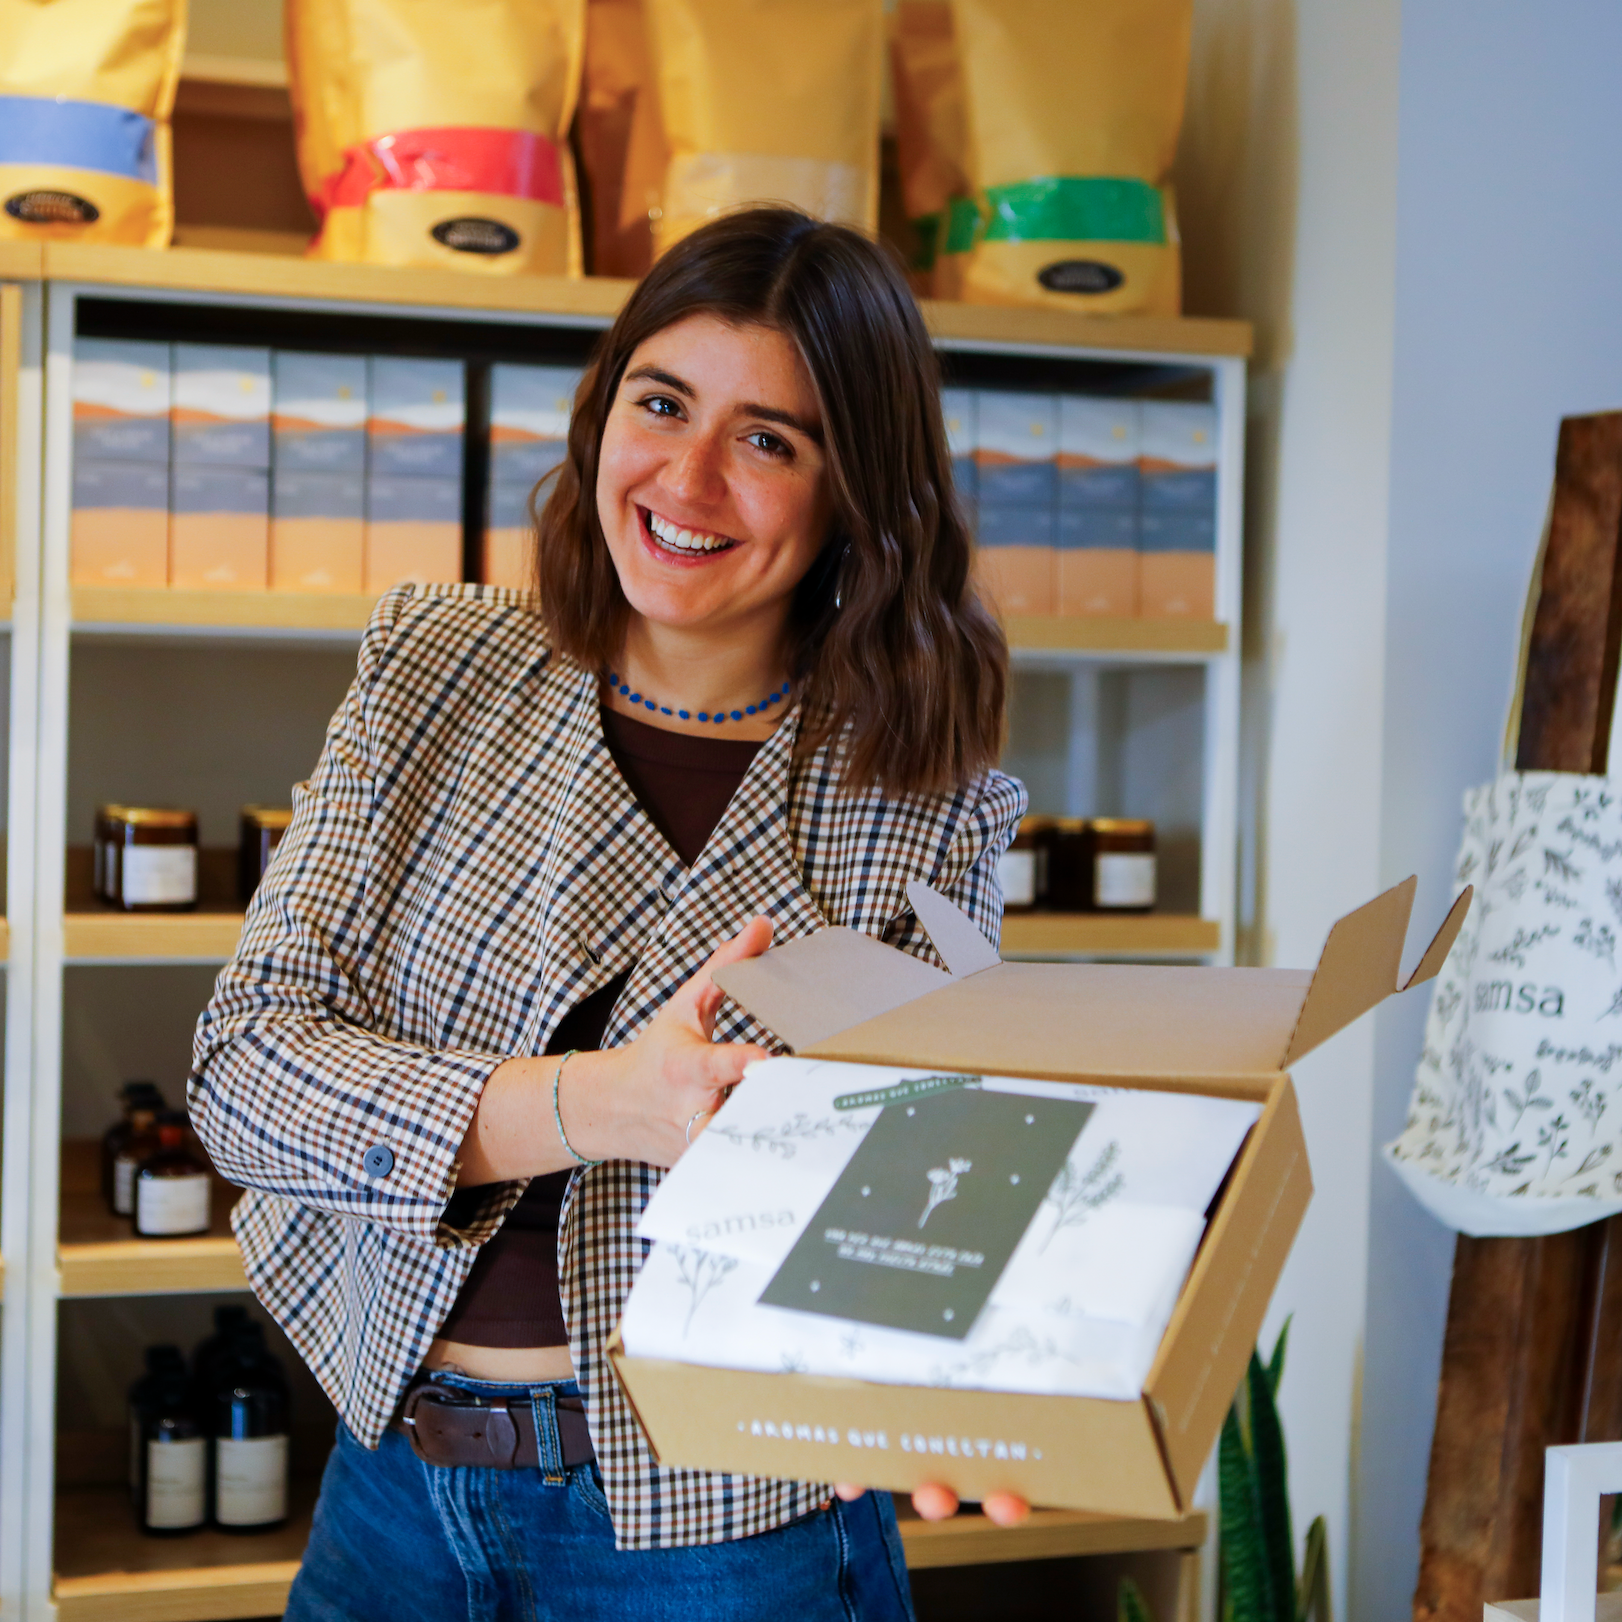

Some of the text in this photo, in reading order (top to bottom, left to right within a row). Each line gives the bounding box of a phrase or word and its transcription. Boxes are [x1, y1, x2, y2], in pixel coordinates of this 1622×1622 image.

[686, 1209, 796, 1246] samsa
[751, 1418, 1027, 1461] AROMAS QUE CONECTAN
